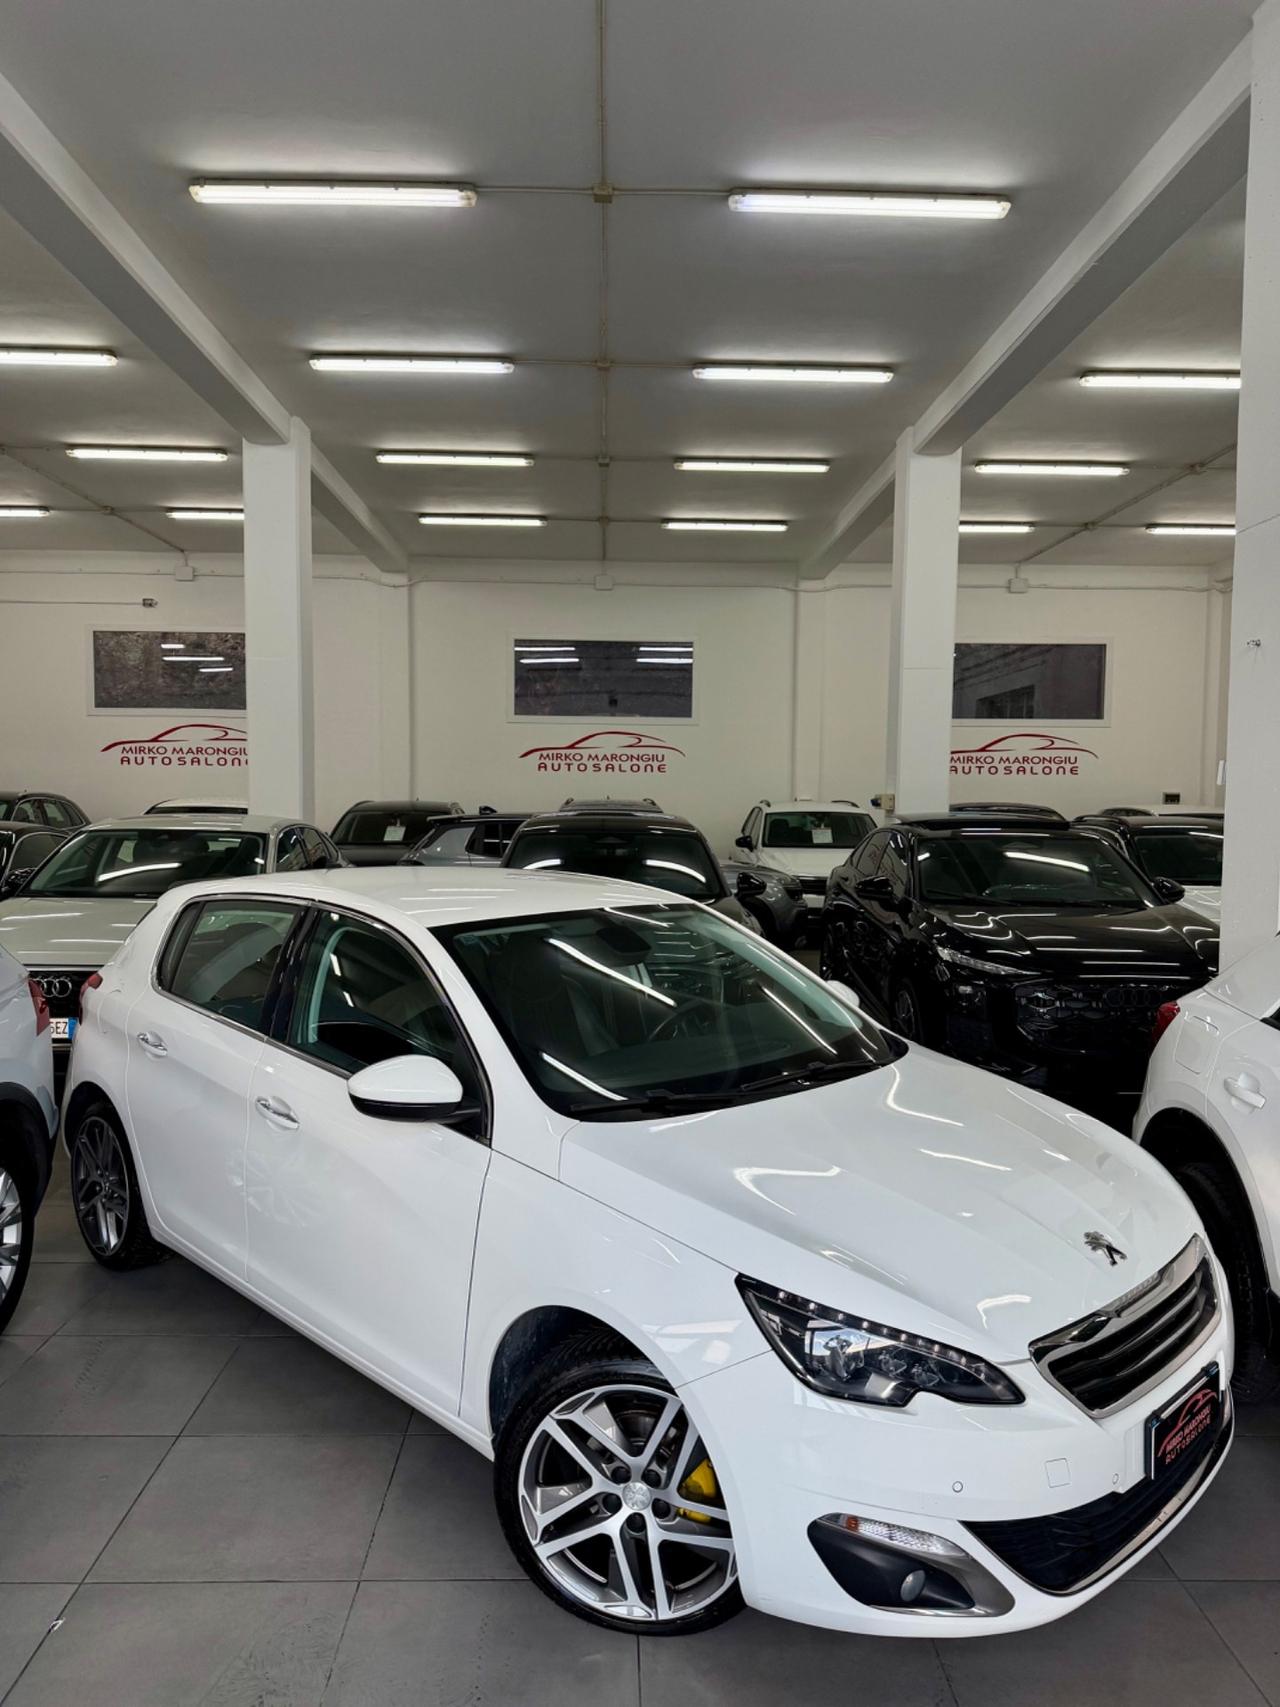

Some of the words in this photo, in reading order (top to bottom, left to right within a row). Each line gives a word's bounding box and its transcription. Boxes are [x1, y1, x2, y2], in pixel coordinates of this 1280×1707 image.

[121, 746, 167, 755] MIRKO
[120, 756, 248, 767] AUTOSALON
[538, 753, 584, 762] MIRKO
[587, 754, 665, 763] MARONGIU
[950, 755, 995, 765] MIRKO
[998, 756, 1078, 765] MARONGIU
[537, 762, 667, 773] AUTOSALONE
[950, 765, 1079, 775] AUTOSALONE
[1165, 1413, 1211, 1465] AUTOSALONE
